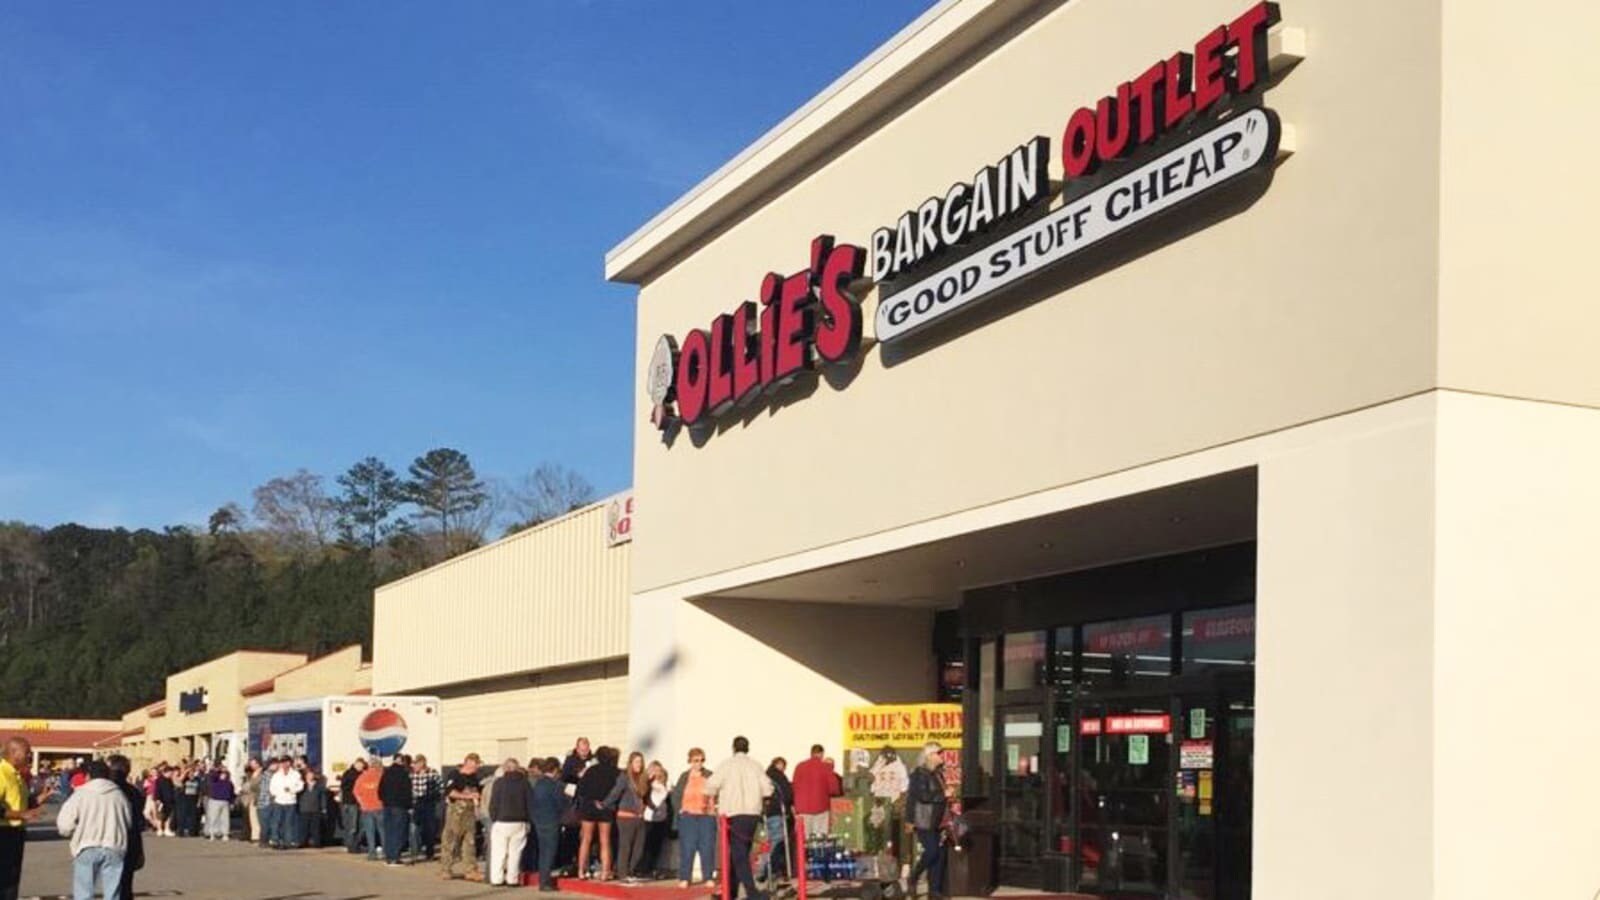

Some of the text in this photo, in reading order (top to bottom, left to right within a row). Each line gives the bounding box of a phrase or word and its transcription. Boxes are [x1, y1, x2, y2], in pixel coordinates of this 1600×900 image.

[872, 138, 1038, 284] BARGAIN
[1062, 2, 1268, 178] OUTLET
[989, 205, 1092, 278] STUFF
[848, 711, 912, 732] OLLIE'S
